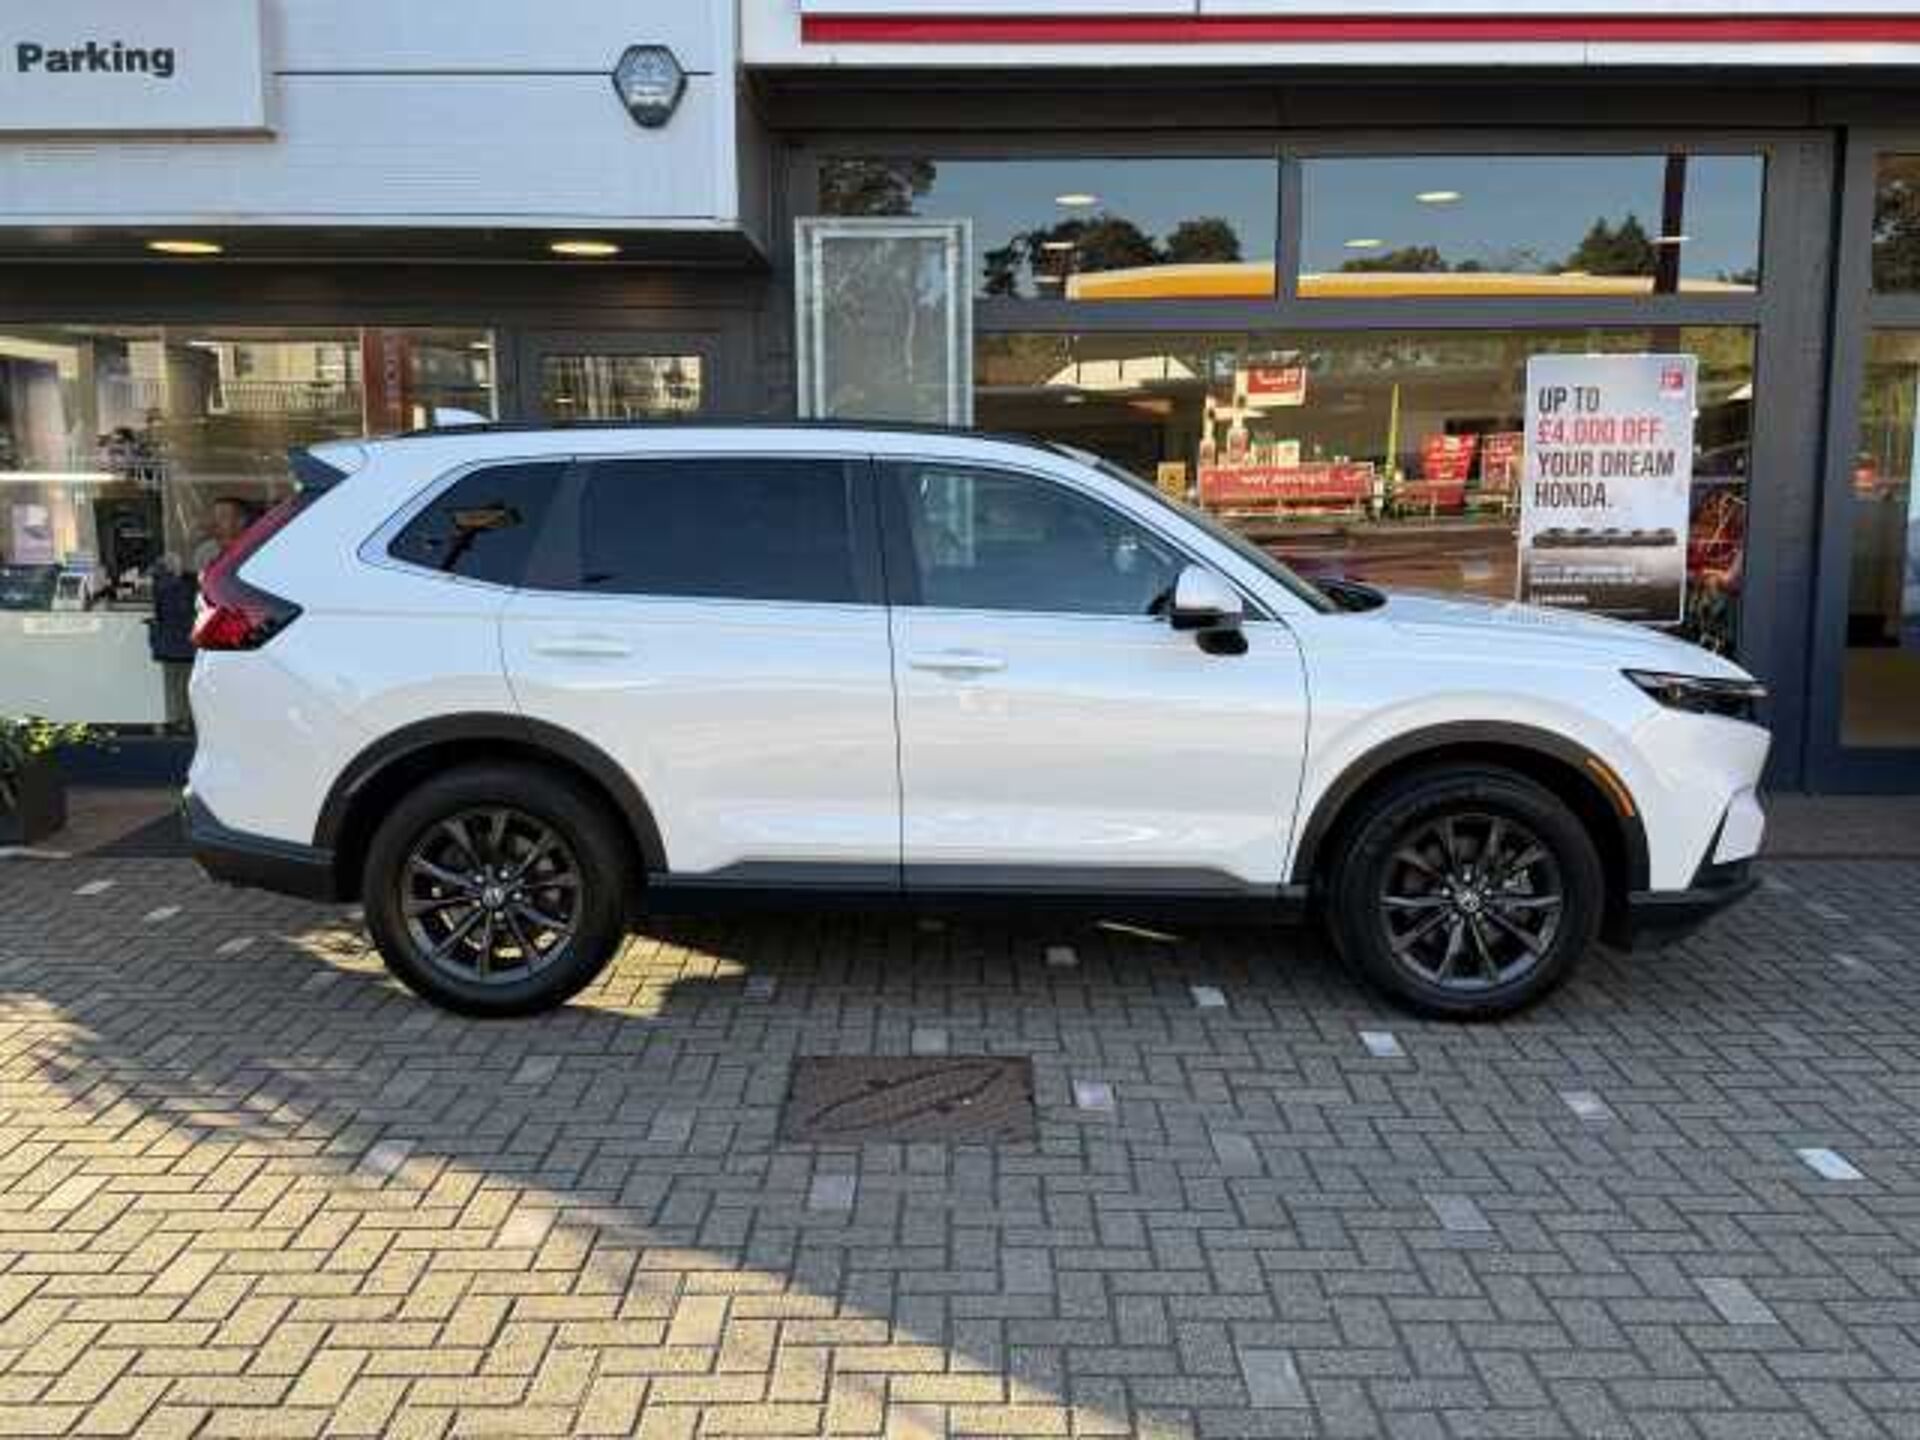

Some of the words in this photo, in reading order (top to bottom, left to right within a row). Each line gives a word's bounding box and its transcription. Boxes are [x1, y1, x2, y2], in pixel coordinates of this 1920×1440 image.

[17, 41, 175, 78] Parking
[1538, 387, 1566, 413] UP
[1575, 387, 1600, 413] TO
[1622, 418, 1661, 444] OFF
[1538, 452, 1593, 477] YOUR
[1601, 452, 1675, 477] DREAM
[1535, 481, 1613, 508] HONDA.
